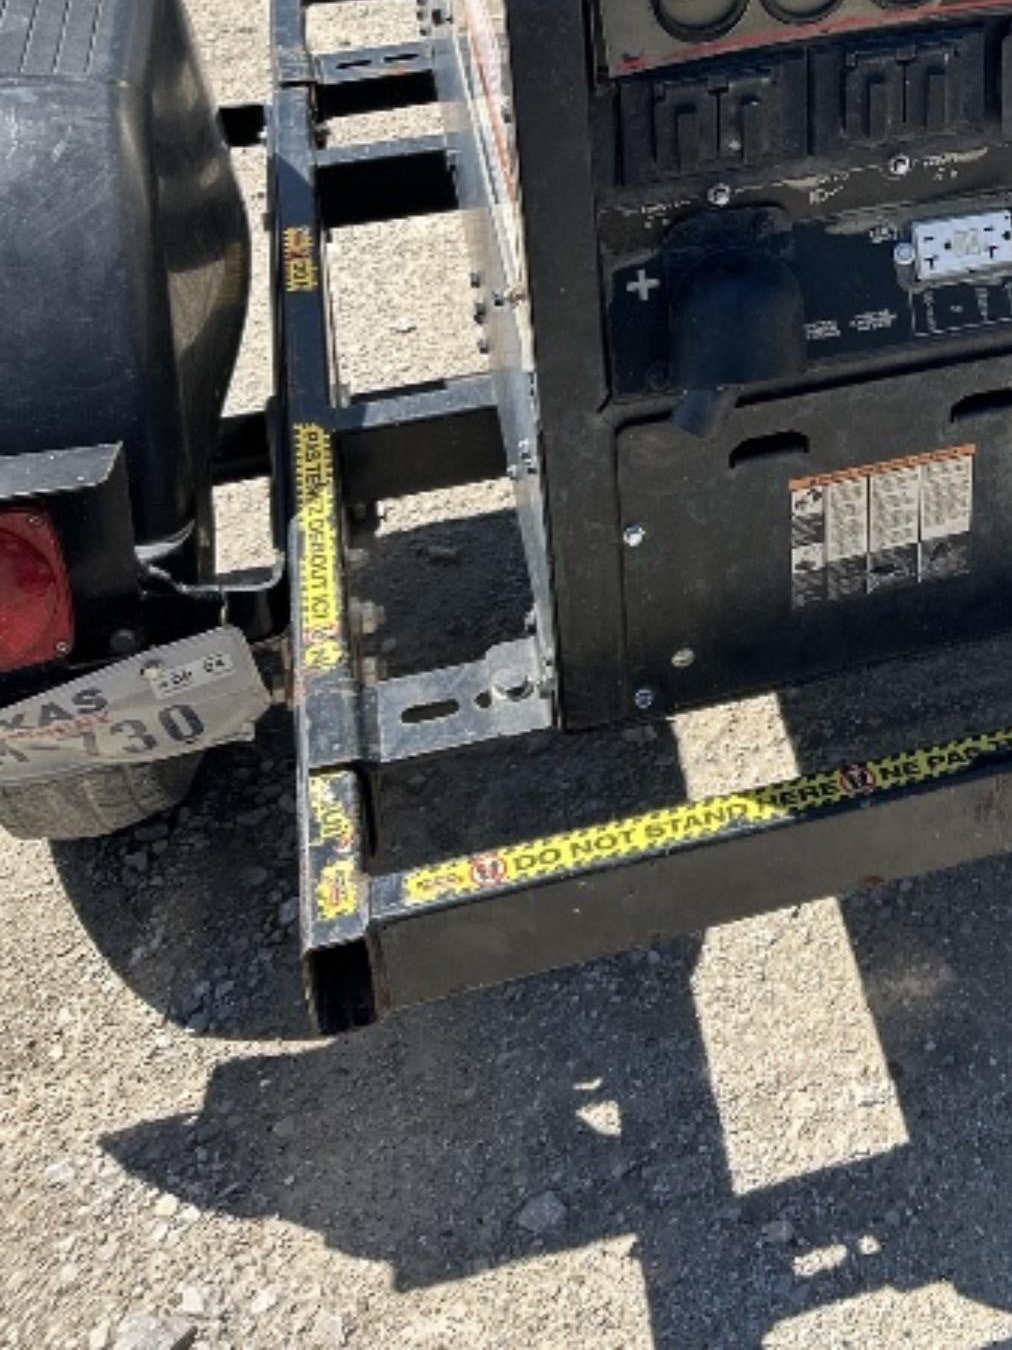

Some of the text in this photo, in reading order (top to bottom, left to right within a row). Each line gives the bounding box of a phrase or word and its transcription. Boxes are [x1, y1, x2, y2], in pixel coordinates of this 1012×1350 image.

[513, 782, 839, 871] DO NOT STAND HERE
